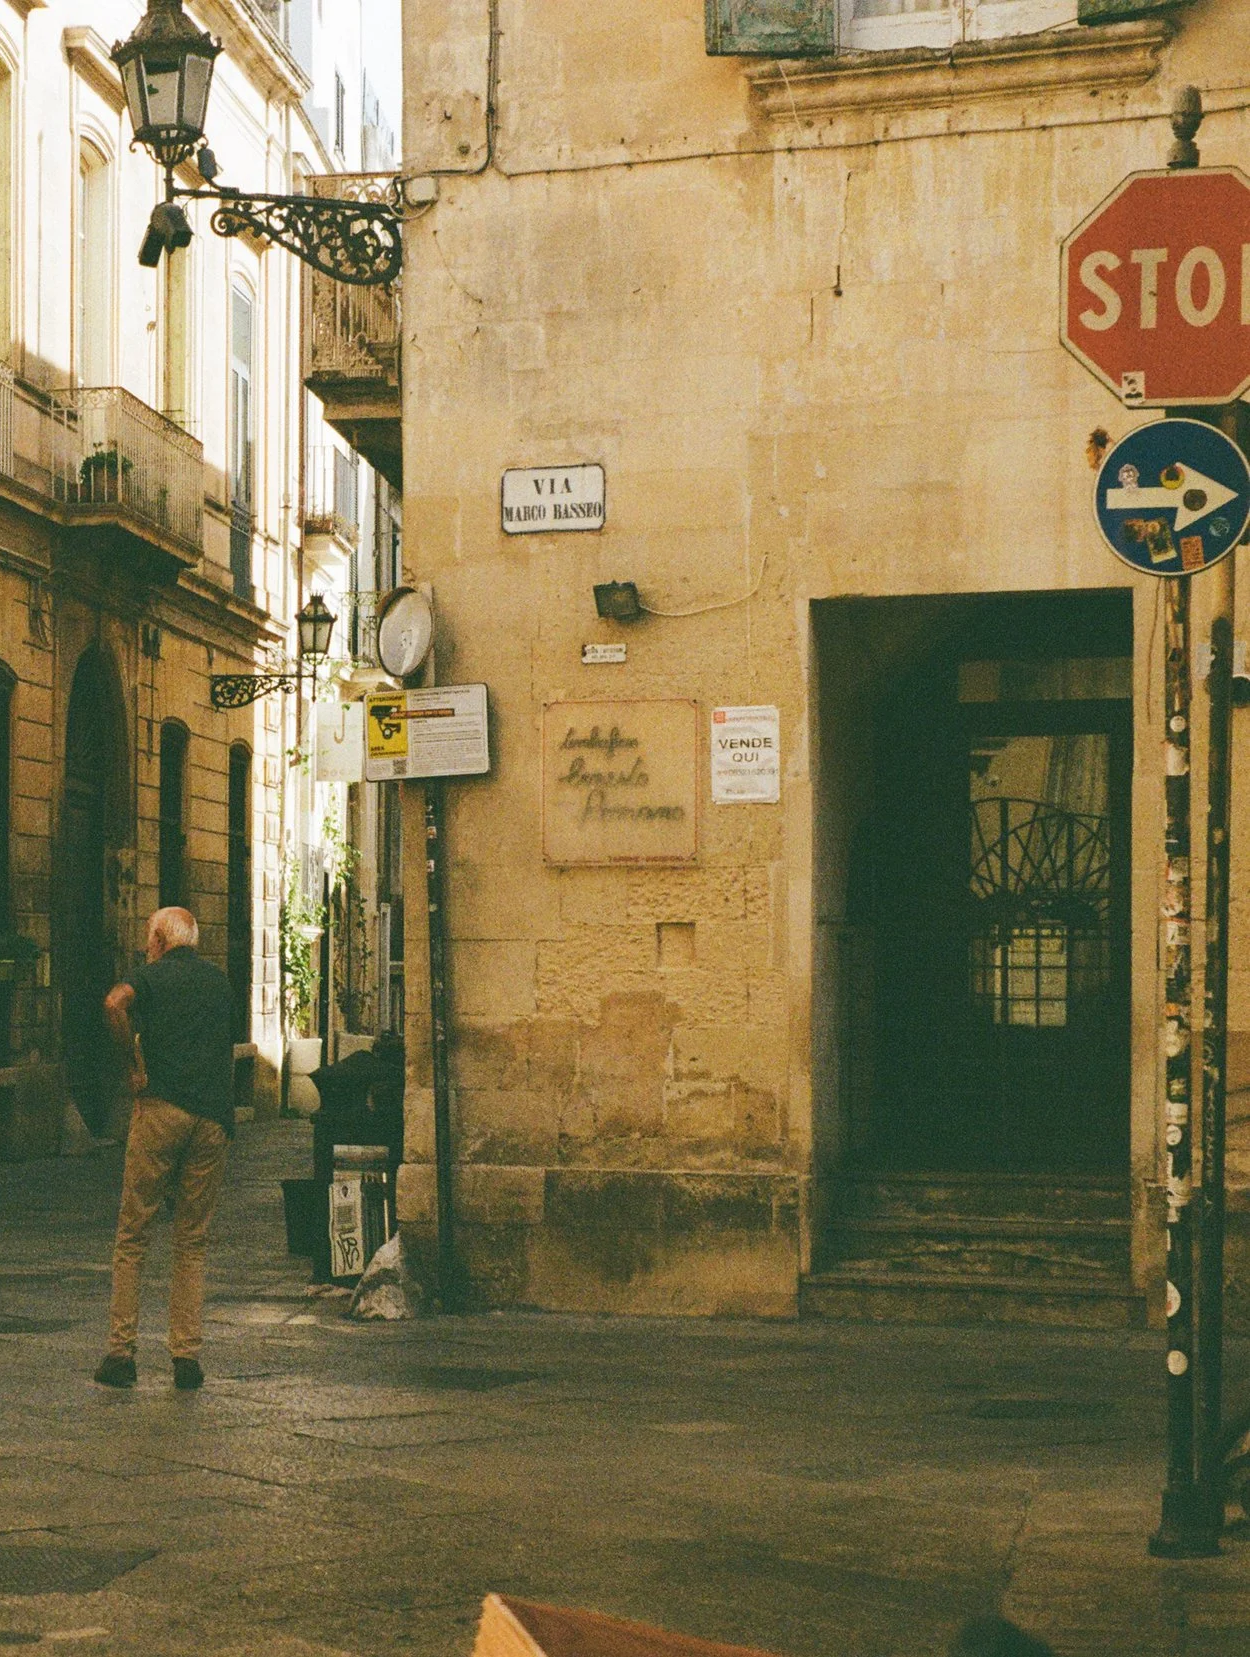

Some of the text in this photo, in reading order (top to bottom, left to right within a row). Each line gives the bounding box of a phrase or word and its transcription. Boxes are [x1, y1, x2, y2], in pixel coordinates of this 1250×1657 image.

[1078, 244, 1250, 331] STO
[533, 477, 572, 495] VIA
[504, 502, 602, 522] MARCO BASSEO
[718, 737, 772, 749] VENDE
[732, 752, 759, 763] QUI
